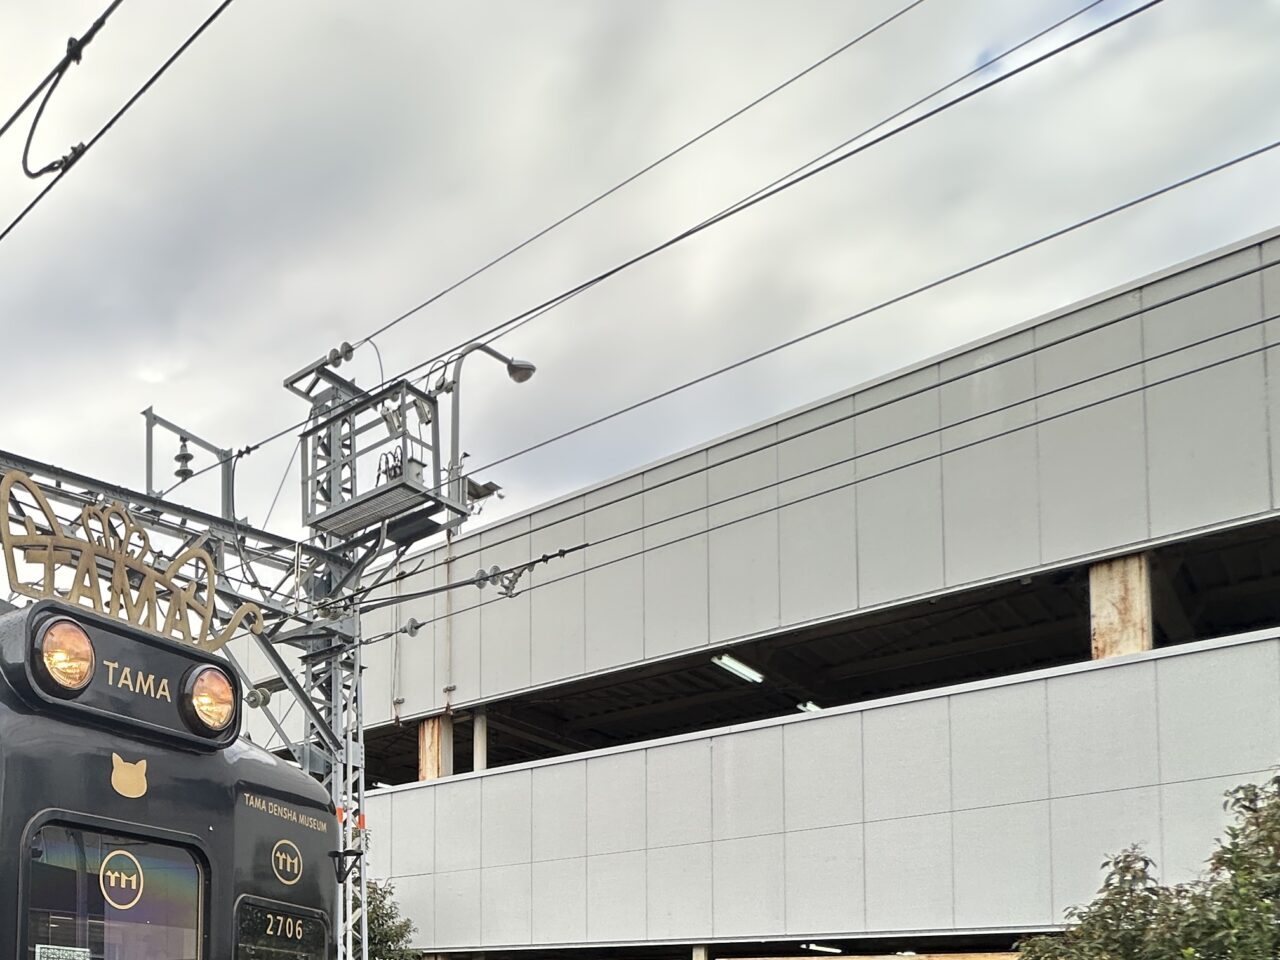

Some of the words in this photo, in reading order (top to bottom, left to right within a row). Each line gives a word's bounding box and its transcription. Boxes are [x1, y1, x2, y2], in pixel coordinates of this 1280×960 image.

[23, 540, 194, 644] TAMA
[103, 660, 171, 703] TAMA
[244, 793, 267, 812] TAMA
[268, 802, 297, 822] DENSHA
[298, 814, 327, 832] MUSEUM
[105, 869, 136, 890] TM
[266, 914, 303, 940] 2706
